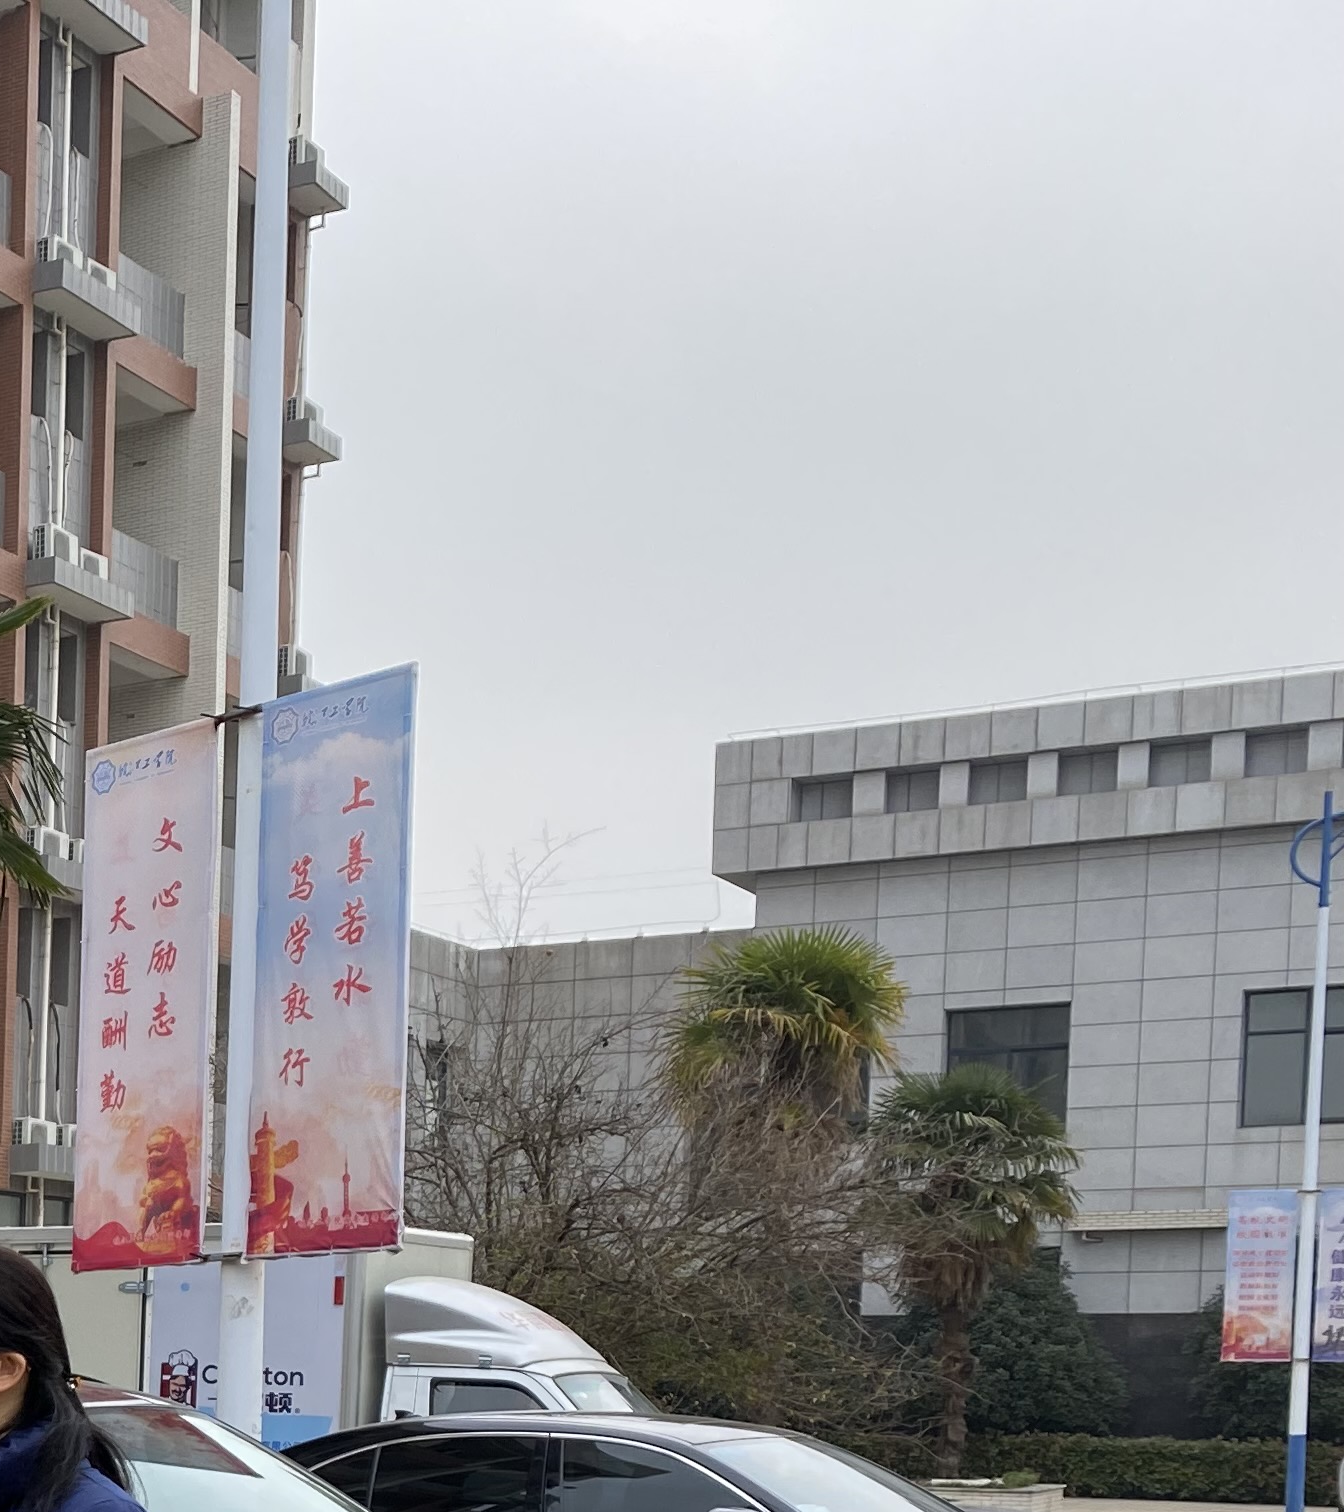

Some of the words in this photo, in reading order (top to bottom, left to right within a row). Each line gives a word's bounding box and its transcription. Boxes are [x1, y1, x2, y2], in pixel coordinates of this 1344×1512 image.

[147, 817, 183, 1039] 文心励志
[278, 854, 315, 1088] 笃学敦行
[333, 776, 376, 1007] 上善若水
[100, 894, 136, 1114] 天道酬勤
[202, 1364, 305, 1387] Cton
